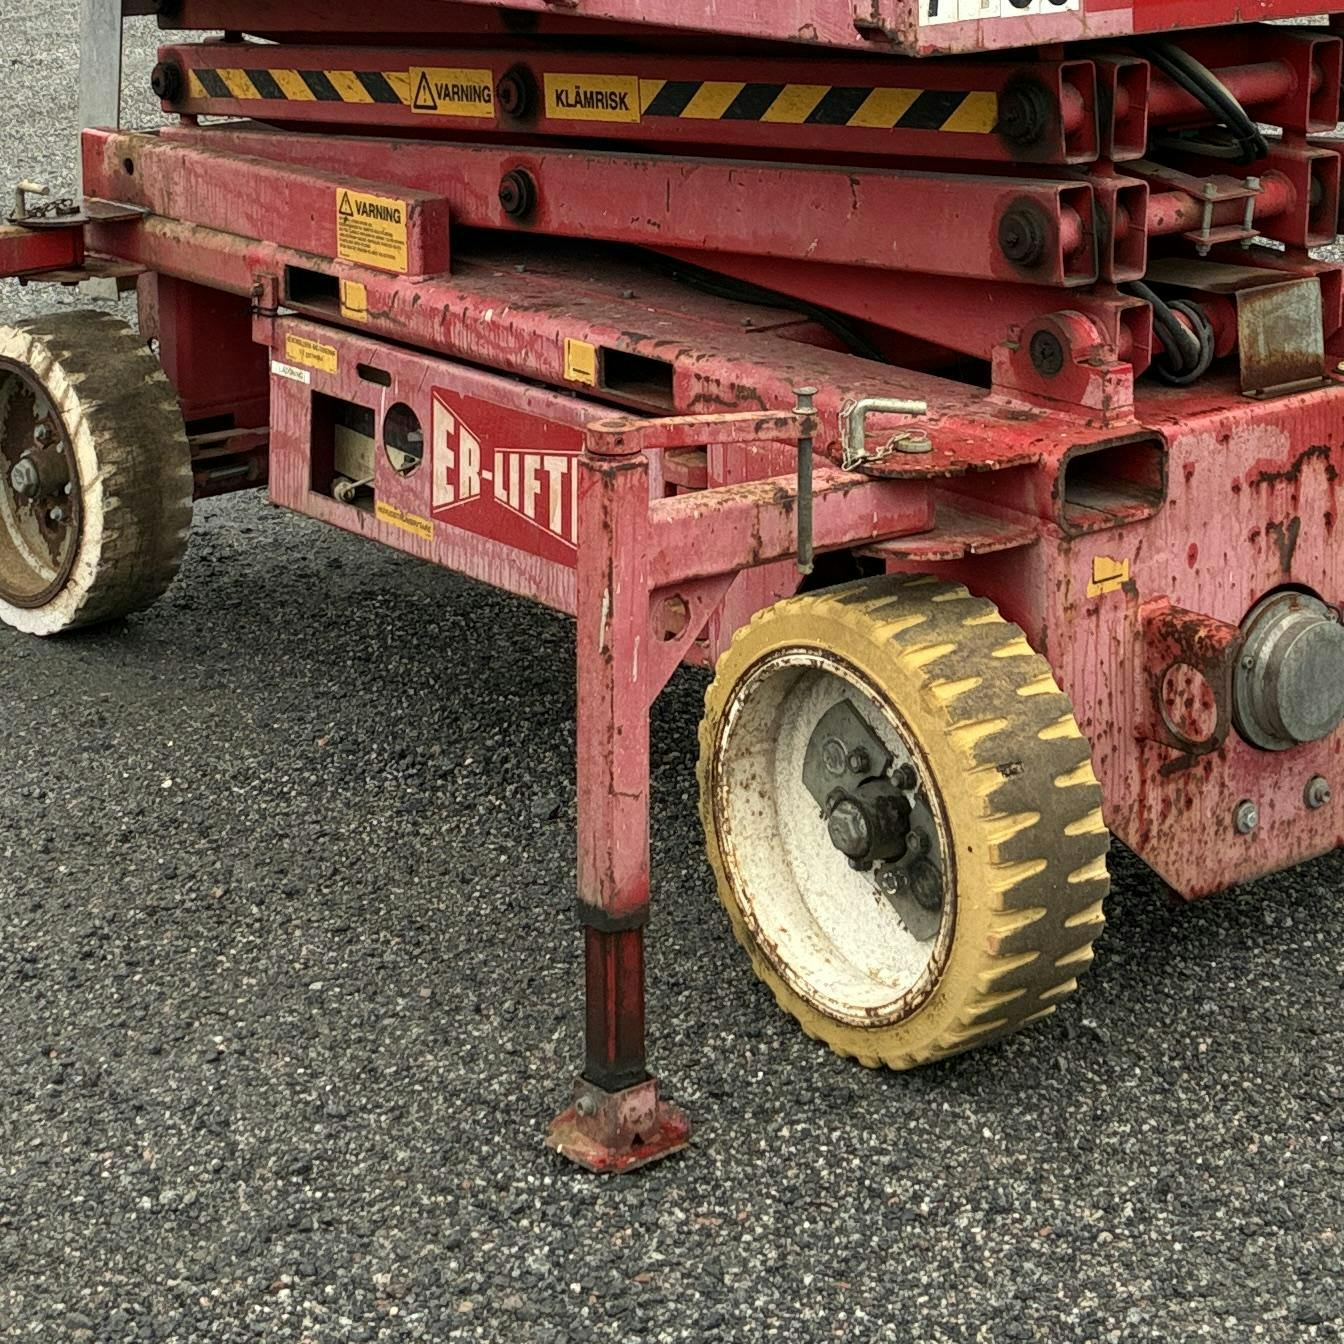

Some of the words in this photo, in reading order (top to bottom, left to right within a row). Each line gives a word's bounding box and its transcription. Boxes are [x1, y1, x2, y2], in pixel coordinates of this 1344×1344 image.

[435, 82, 492, 104] VARNING
[554, 85, 630, 111] KLÄMRISK
[355, 199, 402, 225] VARNING
[432, 397, 578, 545] ER-LIFT
